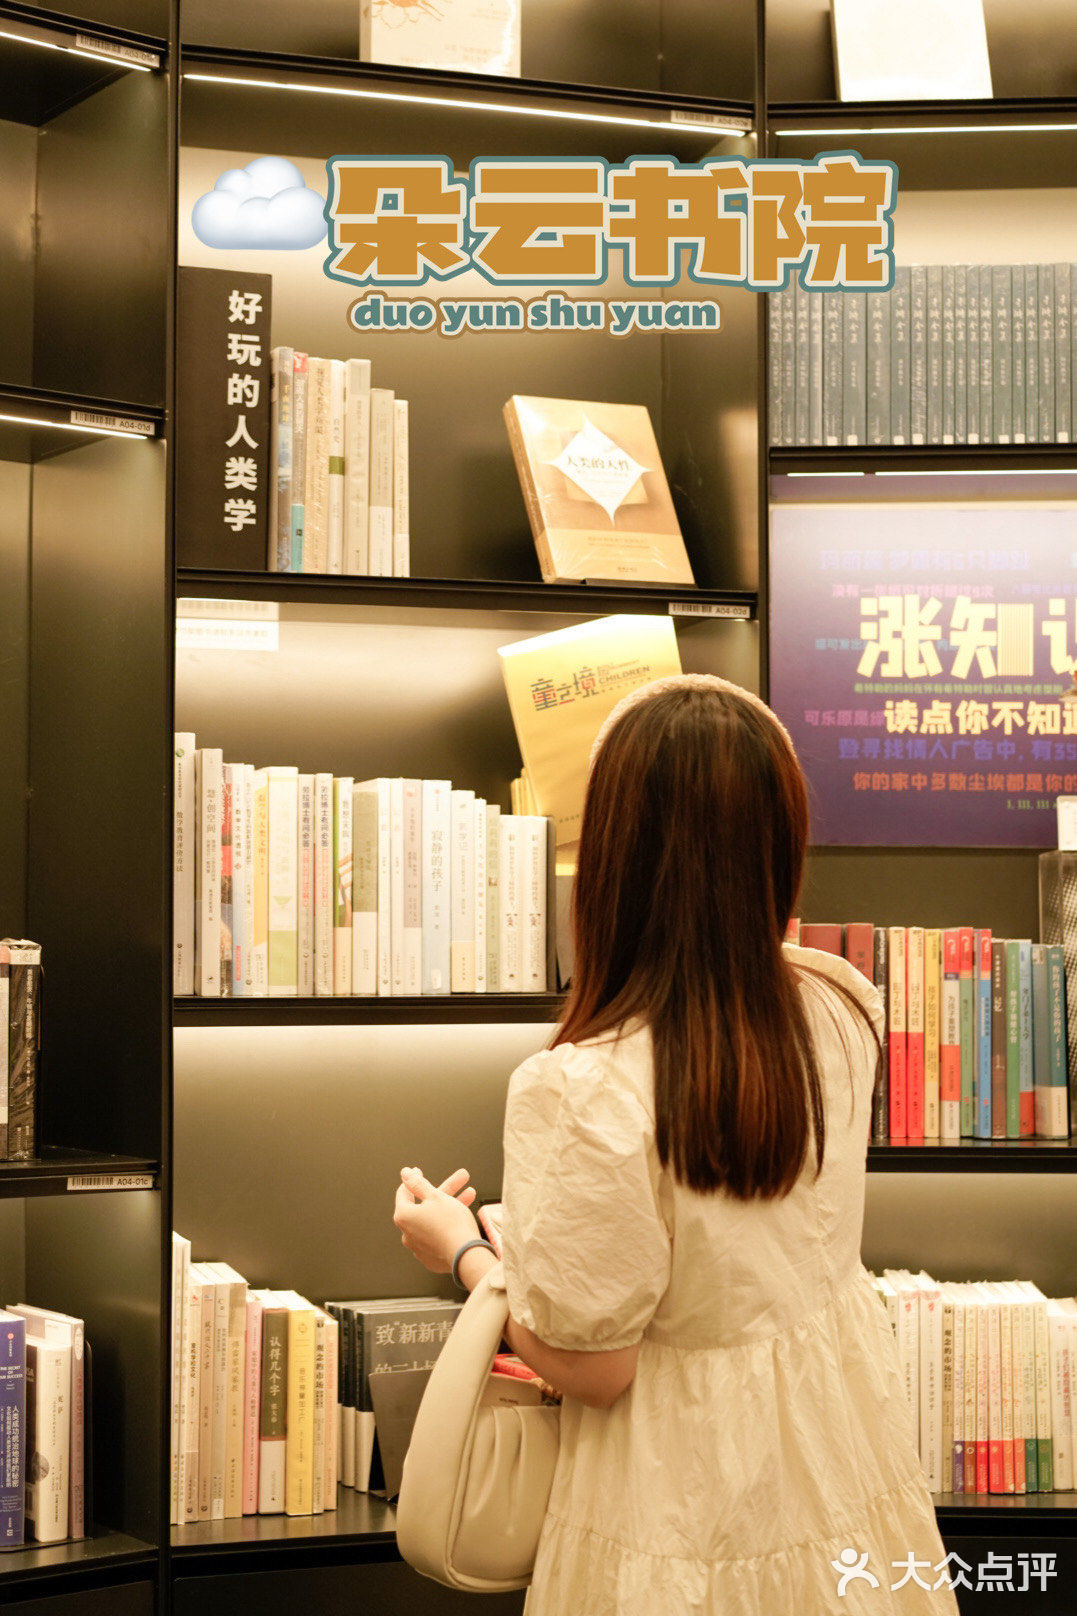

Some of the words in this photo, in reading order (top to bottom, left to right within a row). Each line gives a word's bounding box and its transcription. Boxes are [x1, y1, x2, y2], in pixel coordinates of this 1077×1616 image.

[223, 289, 263, 532] 好玩的人类学
[269, 1336, 281, 1396] 认得几个字
